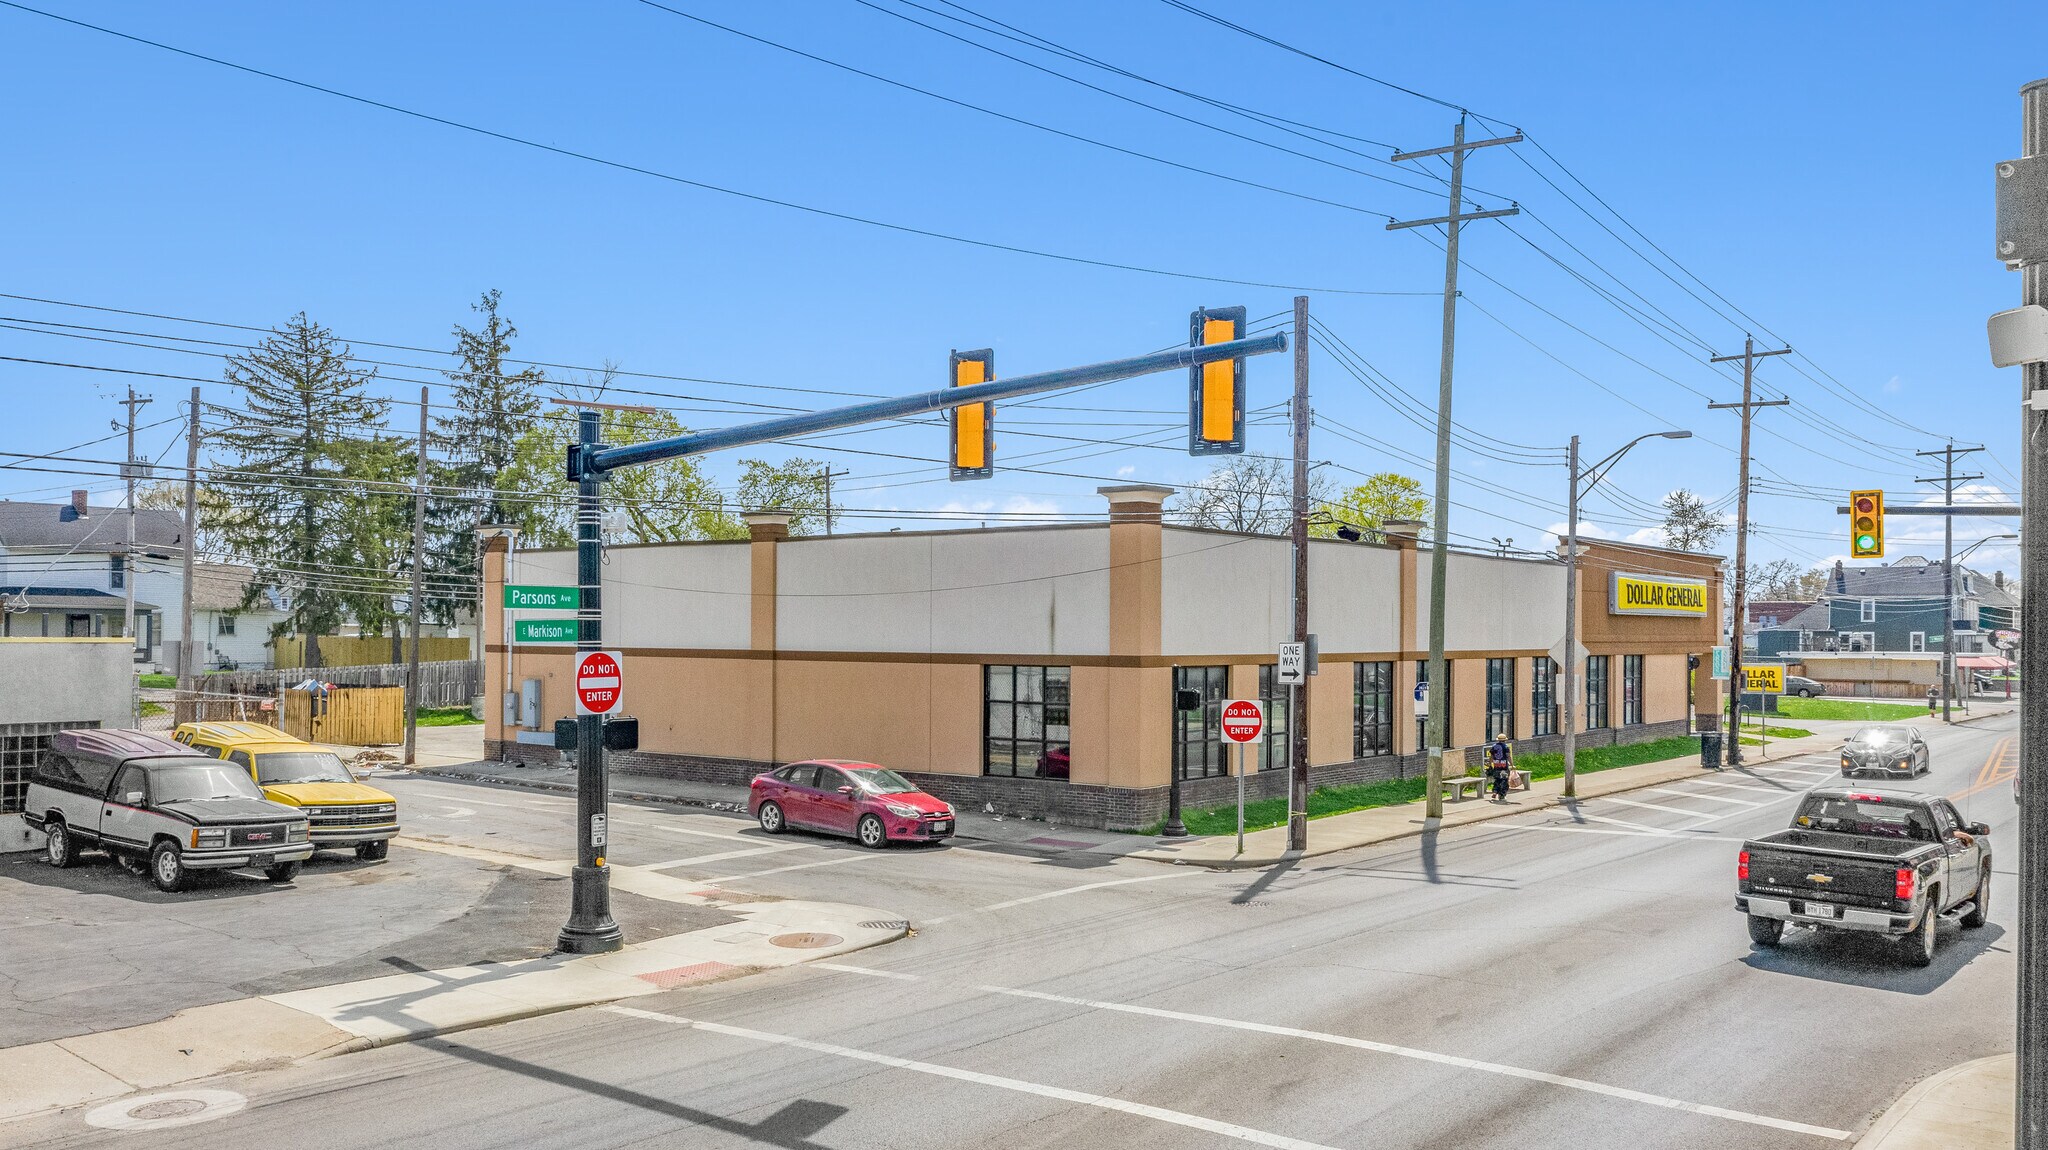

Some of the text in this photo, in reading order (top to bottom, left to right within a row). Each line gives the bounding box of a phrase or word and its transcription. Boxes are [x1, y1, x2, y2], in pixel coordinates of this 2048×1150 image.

[512, 590, 572, 605] Parsons Ave
[1626, 584, 1703, 607] DOLLAR GENERAL
[522, 624, 574, 638] E Markison Ave
[1282, 645, 1300, 655] ONE
[1282, 657, 1300, 666] WAY
[583, 664, 615, 674] DO NOT
[1747, 670, 1775, 679] LLAR
[586, 691, 613, 702] ENTER
[1228, 708, 1256, 716] DO NOT
[1230, 727, 1254, 735] ENTER
[247, 832, 272, 841] GMC
